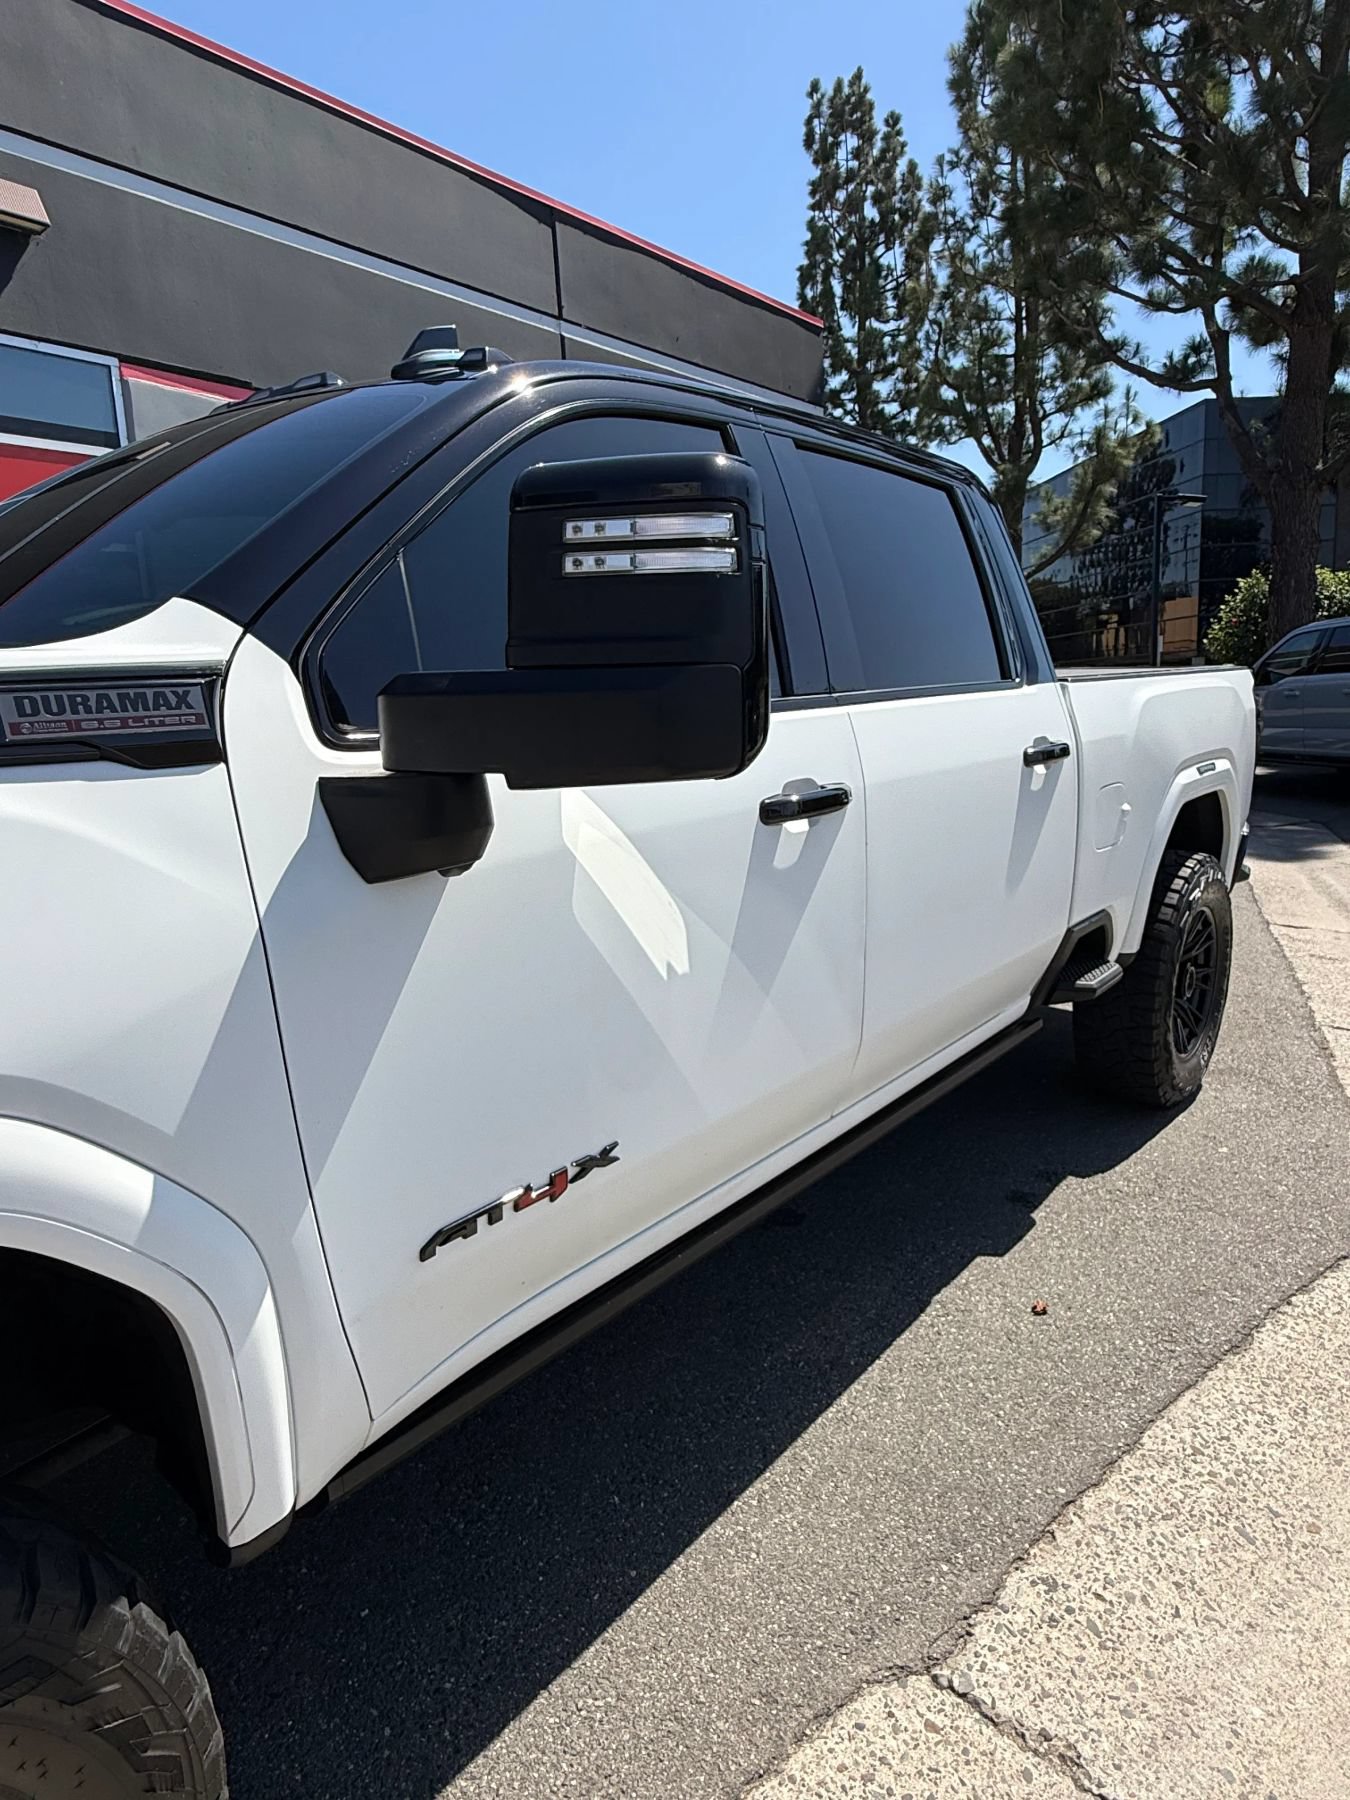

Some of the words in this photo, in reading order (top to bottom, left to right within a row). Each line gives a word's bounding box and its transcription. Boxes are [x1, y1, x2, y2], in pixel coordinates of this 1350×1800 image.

[12, 689, 196, 718] DURAMAX
[127, 715, 197, 727] LITER
[419, 1140, 620, 1262] AT4X
